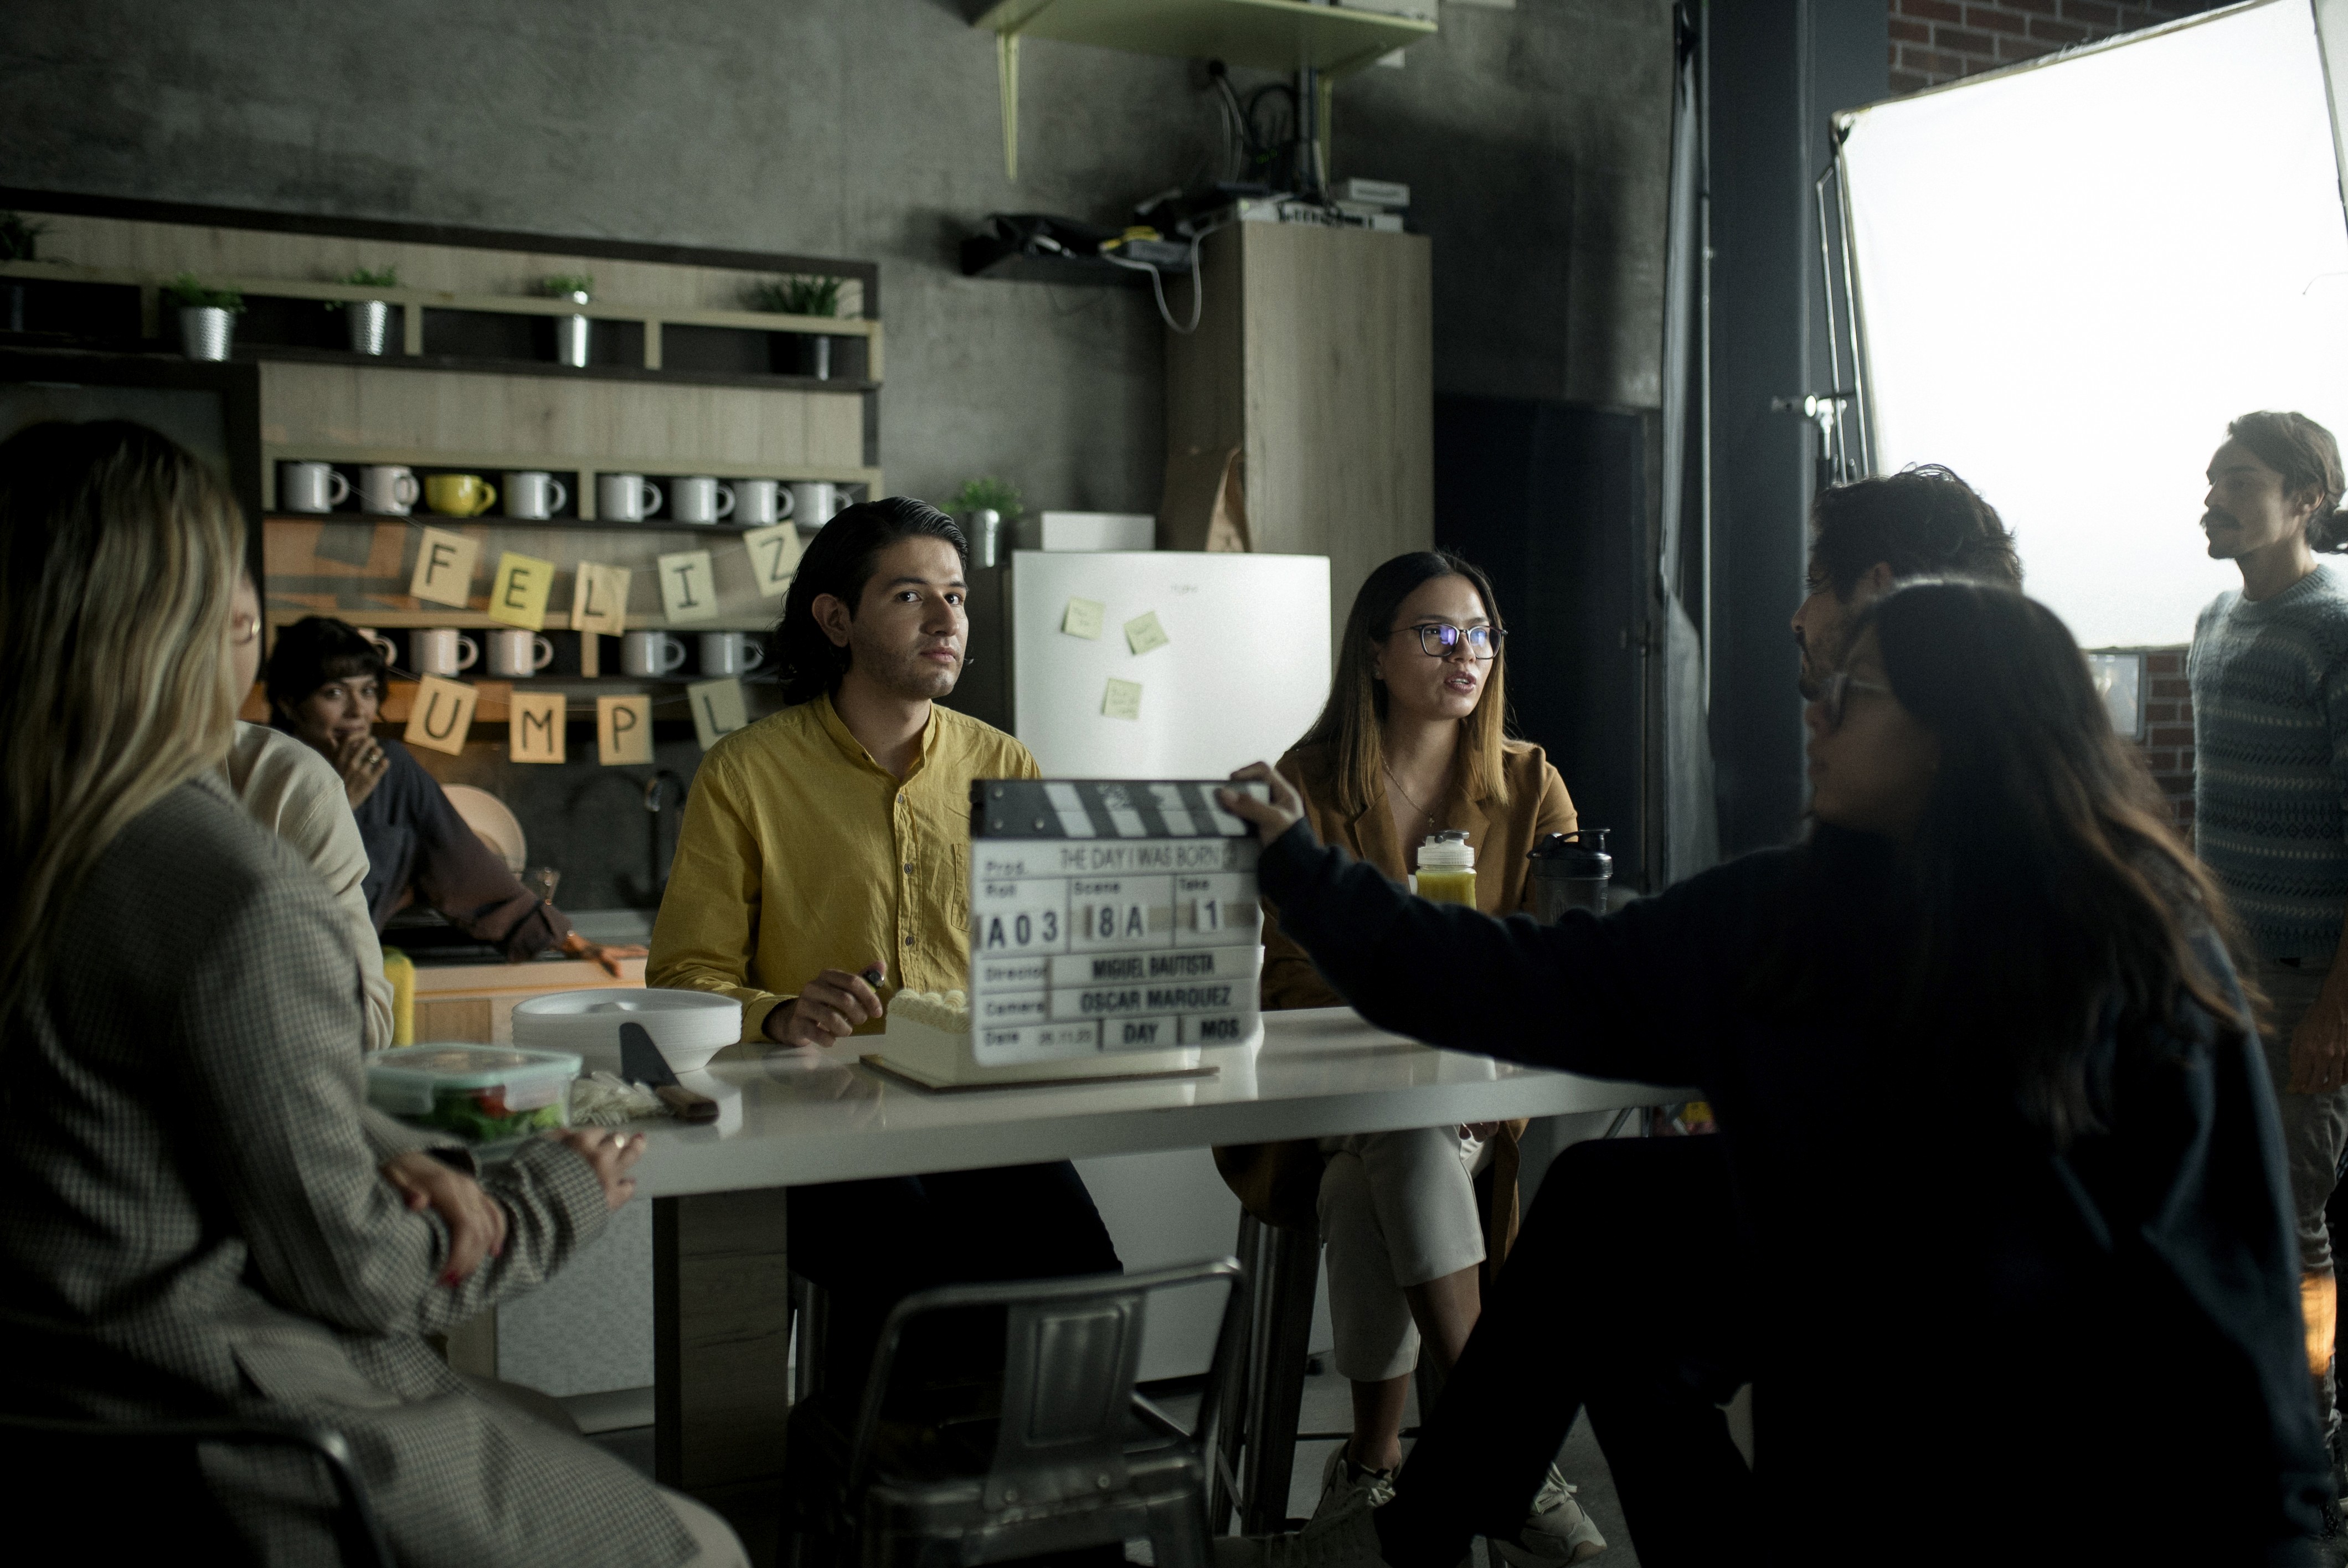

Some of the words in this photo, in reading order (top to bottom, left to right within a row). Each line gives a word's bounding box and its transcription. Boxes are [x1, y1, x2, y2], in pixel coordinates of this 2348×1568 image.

[425, 535, 793, 617] FELIZ
[424, 691, 735, 754] UMPL
[1060, 848, 1087, 870] THE
[1091, 848, 1125, 869] DAY
[1137, 846, 1172, 868] WAS
[1074, 881, 1121, 895] Scene
[1179, 878, 1209, 891] Take
[987, 911, 1058, 948] A03
[984, 965, 1047, 982] Director
[1092, 957, 1145, 980] MIGUEL
[1150, 954, 1214, 977] BAUTISTA
[985, 1001, 1046, 1017] Camera
[1079, 991, 1141, 1014] OSCAR
[1146, 985, 1232, 1009] MARQUEZ
[1124, 1023, 1158, 1045] DAY
[1201, 1018, 1240, 1040] MOS
